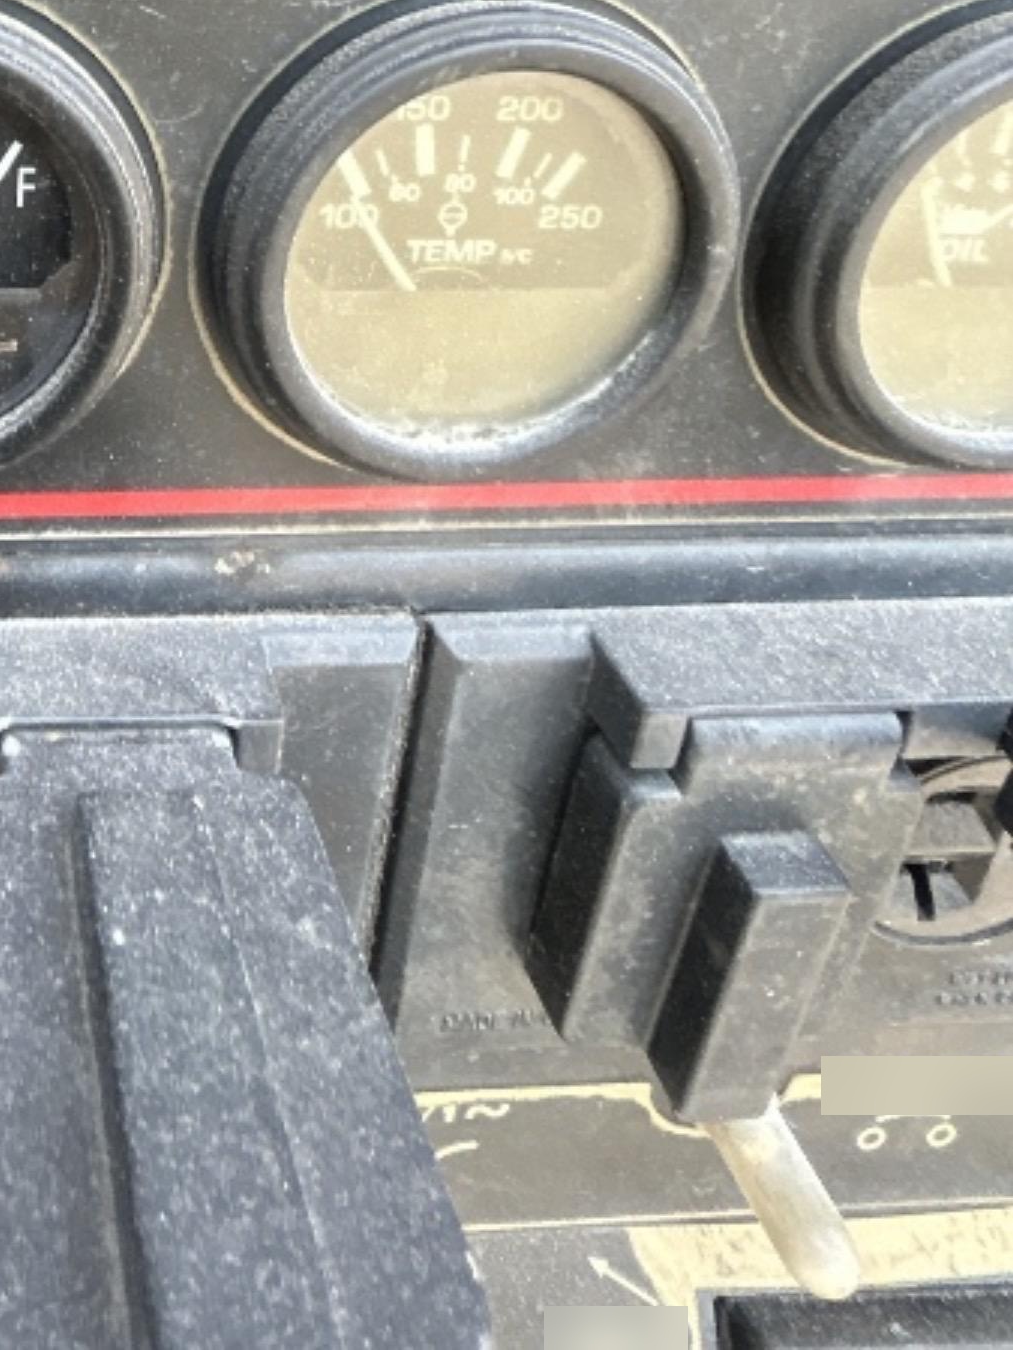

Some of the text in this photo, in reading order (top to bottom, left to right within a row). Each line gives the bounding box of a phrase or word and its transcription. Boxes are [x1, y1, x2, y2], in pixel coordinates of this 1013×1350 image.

[496, 96, 564, 122] 200
[16, 166, 37, 209] F
[319, 205, 379, 230] 100
[538, 204, 604, 229] 250
[406, 239, 498, 264] TEMP
